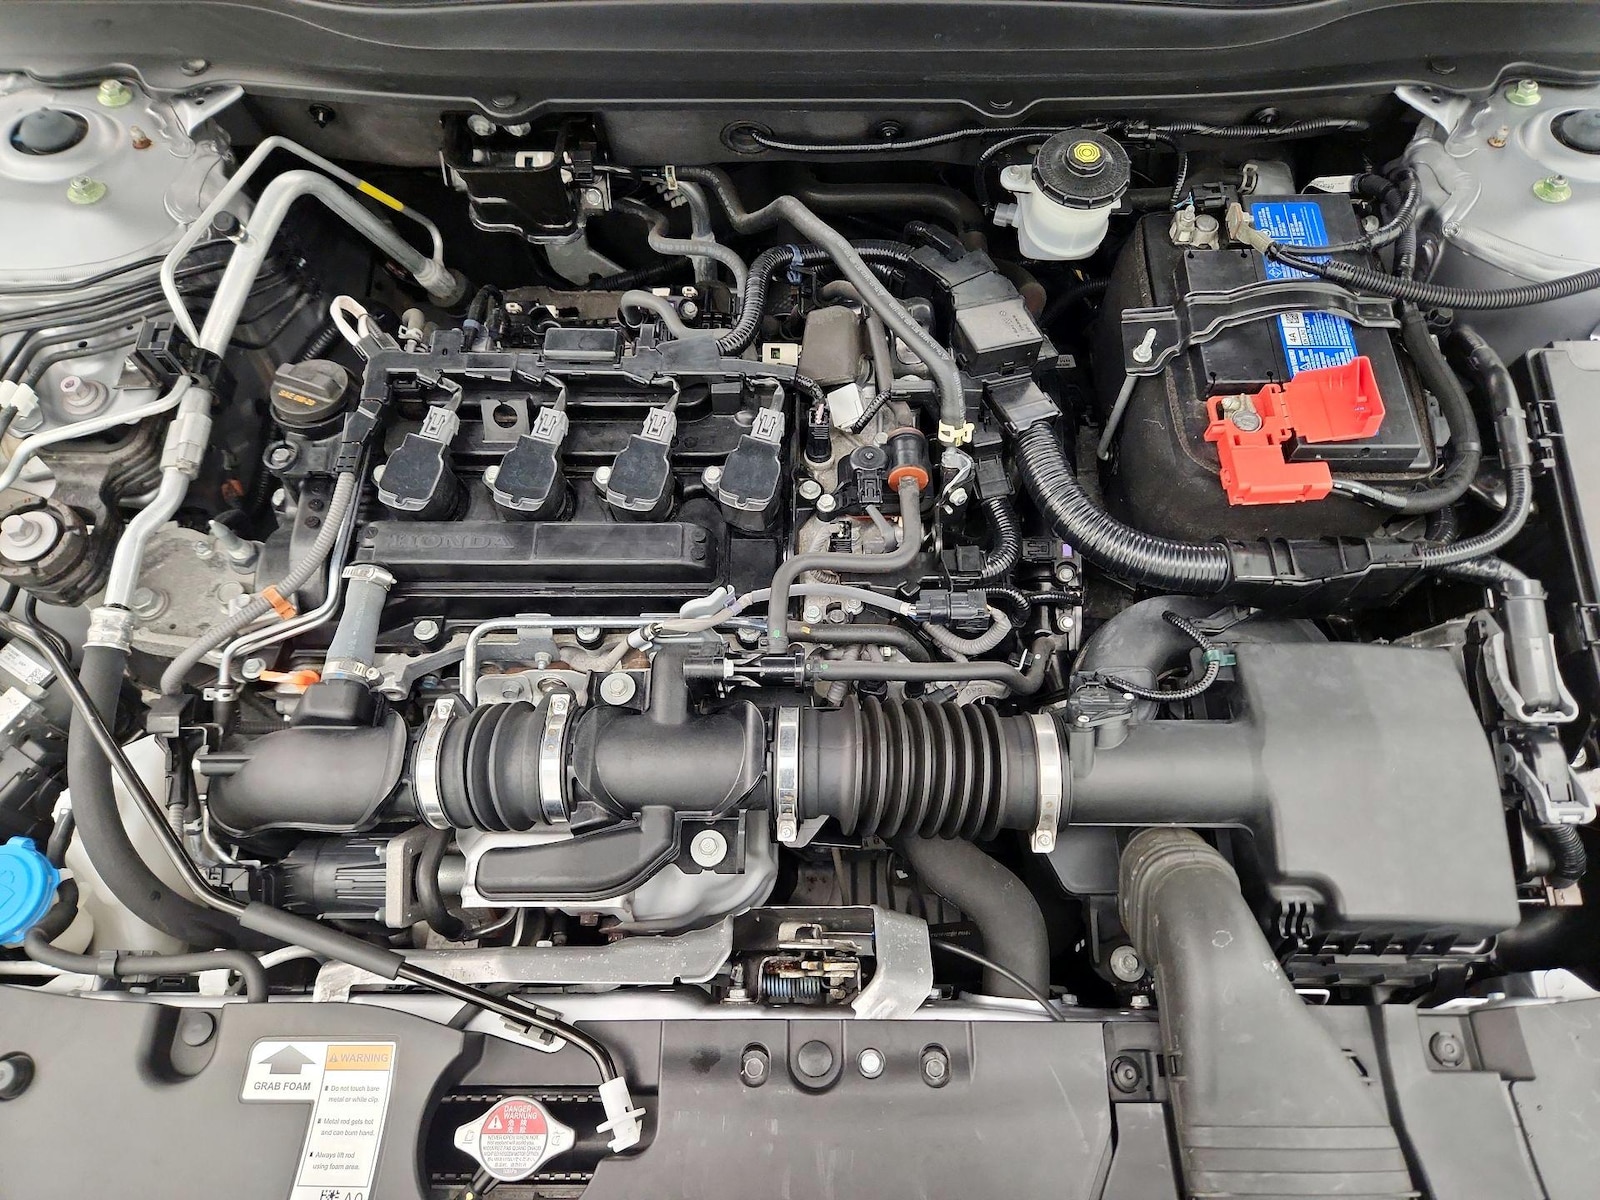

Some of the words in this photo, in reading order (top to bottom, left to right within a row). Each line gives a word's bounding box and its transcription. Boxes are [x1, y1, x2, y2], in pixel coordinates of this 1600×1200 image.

[389, 533, 515, 549] HONDA
[340, 1053, 388, 1063] WARNING
[254, 1081, 281, 1091] GRAB
[283, 1081, 312, 1091] FOAM
[503, 1105, 532, 1113] DANGER
[503, 1112, 538, 1120] WARNUNG
[350, 1118, 363, 1126] gets
[315, 1152, 336, 1160] Always
[312, 1163, 329, 1171] using
